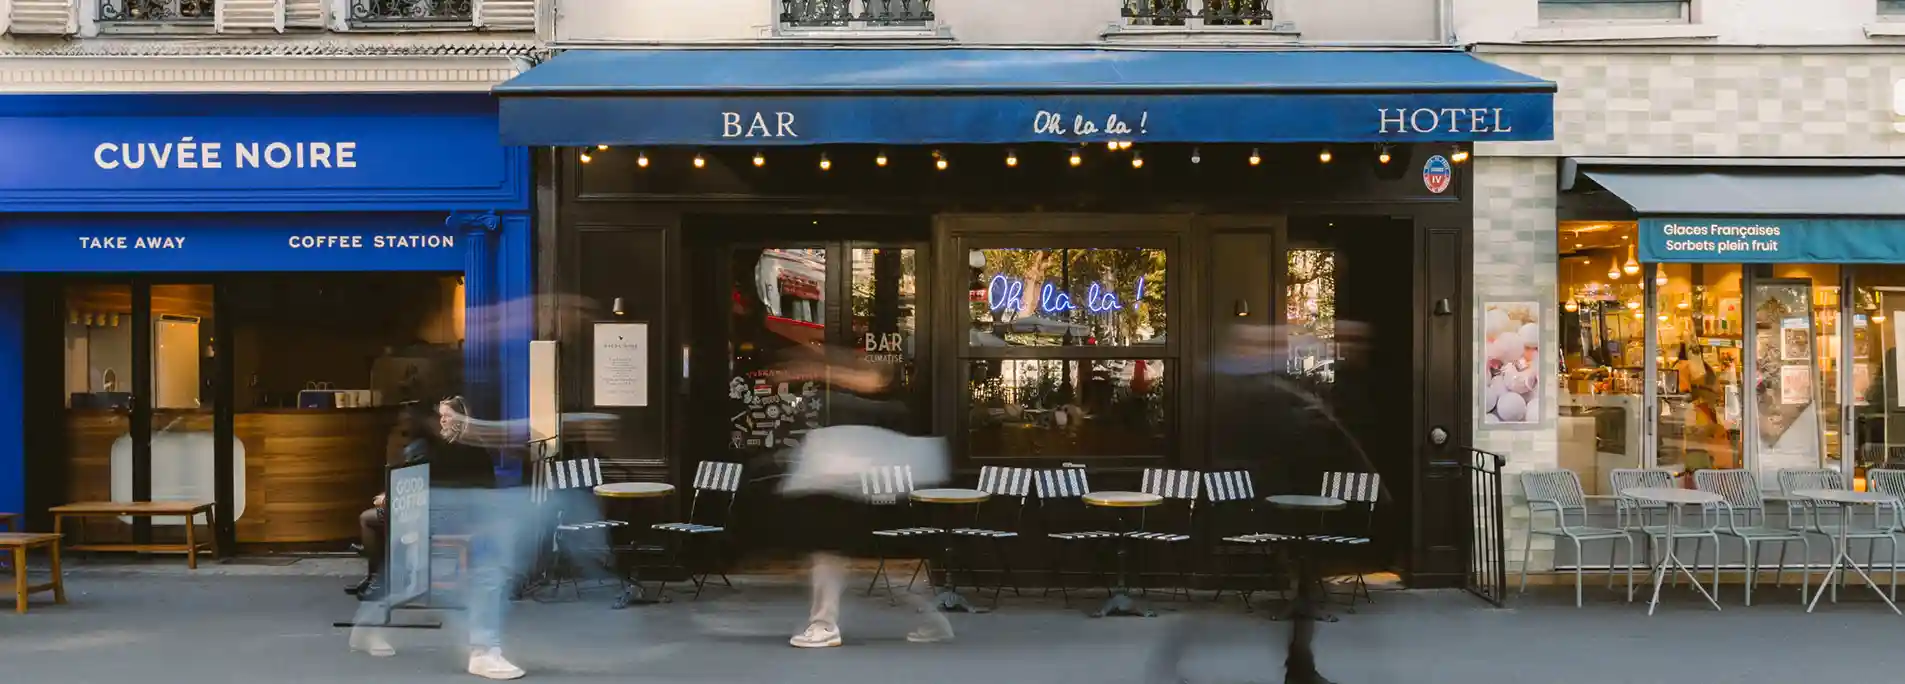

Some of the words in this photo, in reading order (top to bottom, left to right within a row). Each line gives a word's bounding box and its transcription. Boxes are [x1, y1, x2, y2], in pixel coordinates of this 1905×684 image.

[721, 111, 799, 137] BAR
[1033, 110, 1066, 135] Oh
[1073, 114, 1099, 135] la
[1104, 113, 1132, 134] la
[1140, 111, 1147, 134] !
[1378, 107, 1512, 133] HOTEL
[94, 136, 222, 170] CUVÉE
[235, 141, 357, 169] NOIRE
[1663, 223, 1708, 236] Glaces
[1711, 224, 1781, 239] Françaises
[79, 236, 128, 249] TAKE
[134, 236, 186, 249] AWAY
[288, 235, 363, 249] COFFEE
[373, 235, 454, 248] STATION
[1665, 239, 1715, 251] Sorbets
[1718, 239, 1749, 254] plein
[1751, 239, 1778, 251] fruit
[988, 274, 1025, 312] Oh
[1042, 283, 1076, 312] la
[1088, 282, 1121, 312] la
[1134, 276, 1144, 310] !
[865, 332, 902, 351] BAR
[396, 476, 424, 495] GOOD
